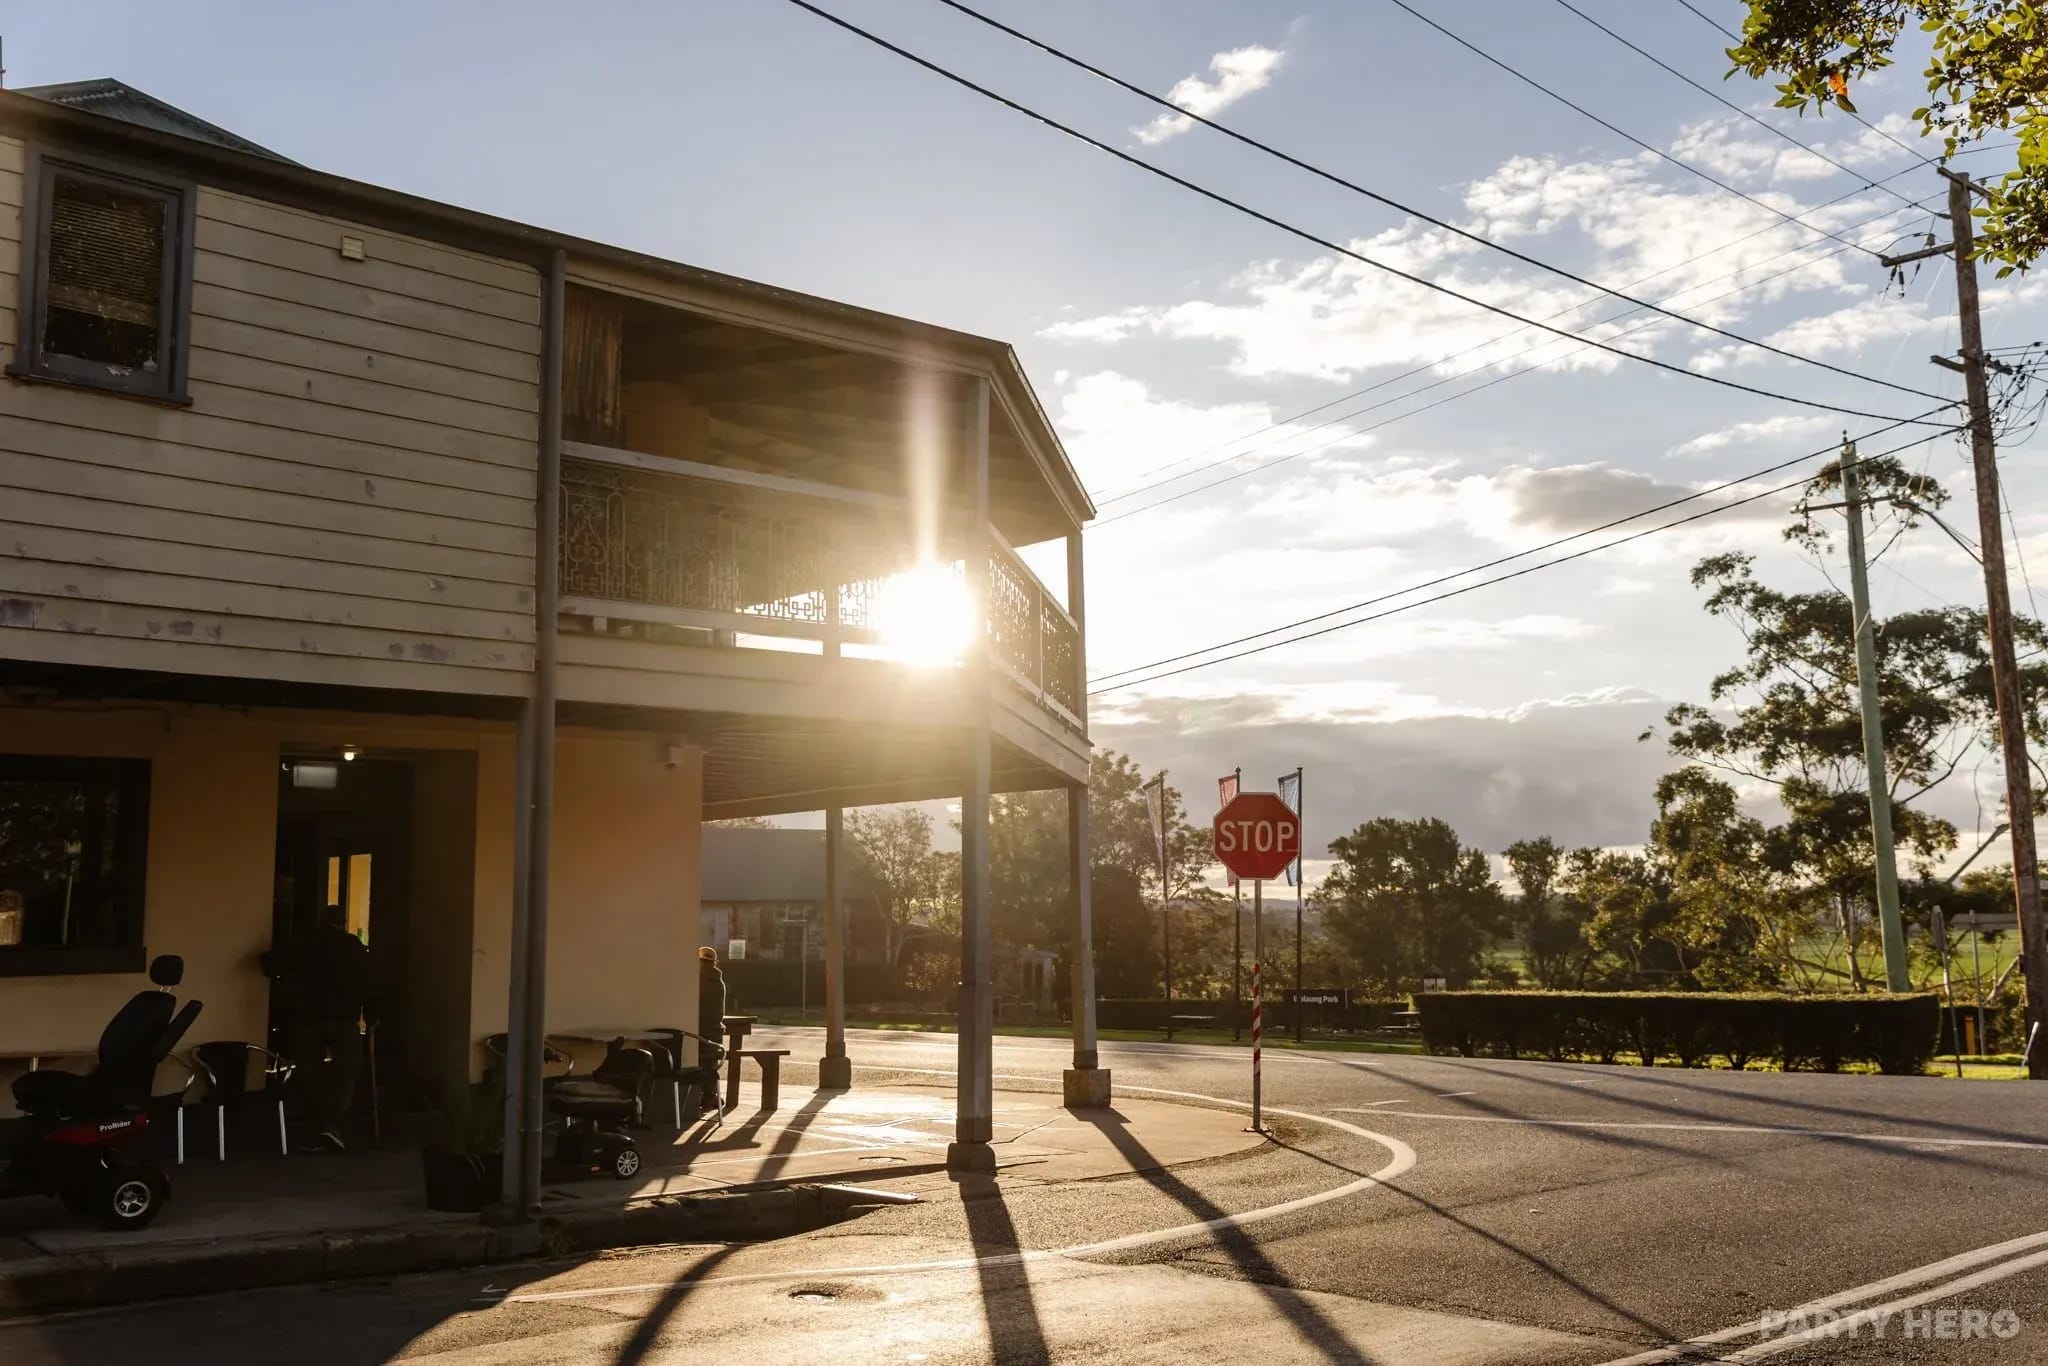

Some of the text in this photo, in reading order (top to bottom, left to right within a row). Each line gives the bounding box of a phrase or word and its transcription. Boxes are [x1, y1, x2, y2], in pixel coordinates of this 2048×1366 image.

[1219, 820, 1294, 852] STOP
[1323, 995, 1338, 1003] Park
[99, 1120, 132, 1132] ProRider
